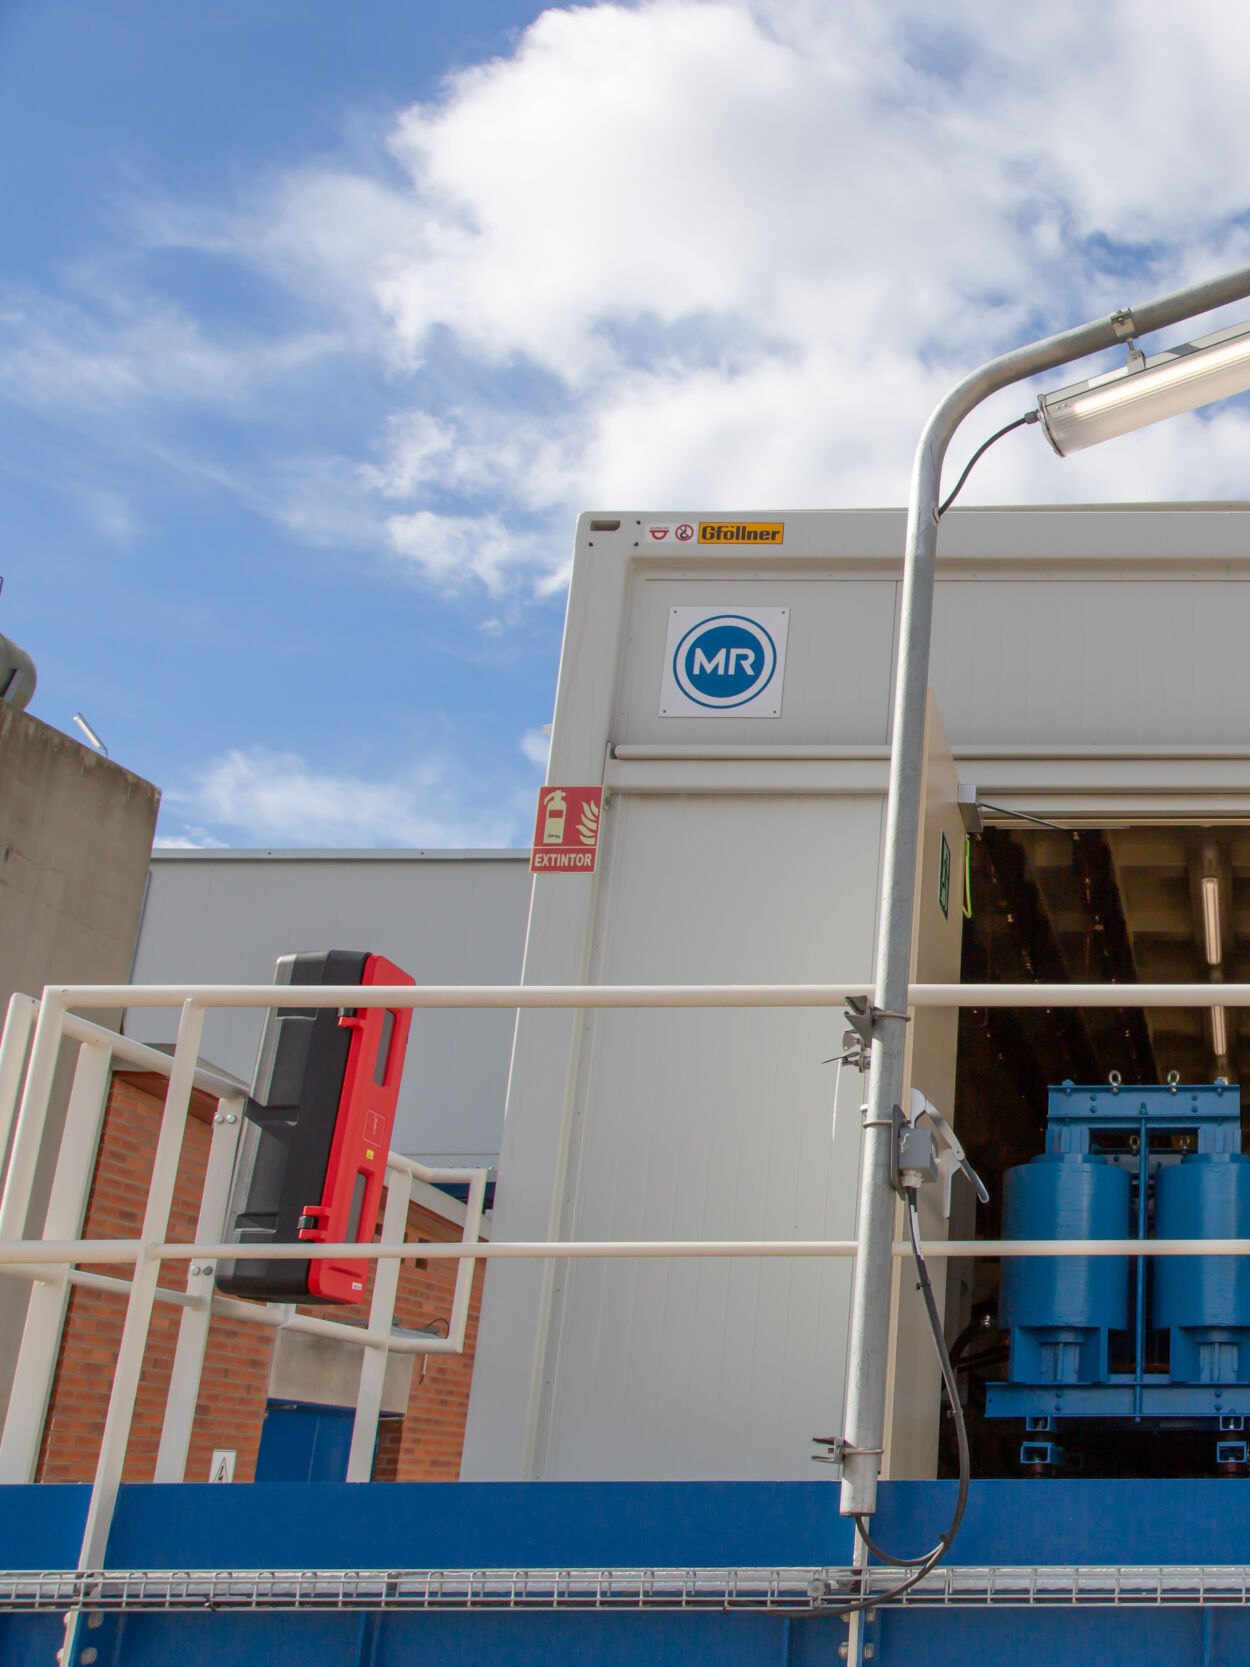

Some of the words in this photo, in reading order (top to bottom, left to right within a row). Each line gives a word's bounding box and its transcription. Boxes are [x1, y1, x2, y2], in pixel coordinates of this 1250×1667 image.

[701, 525, 780, 541] Gföllner
[693, 647, 755, 675] MR
[534, 853, 592, 867] EXTINTOR
